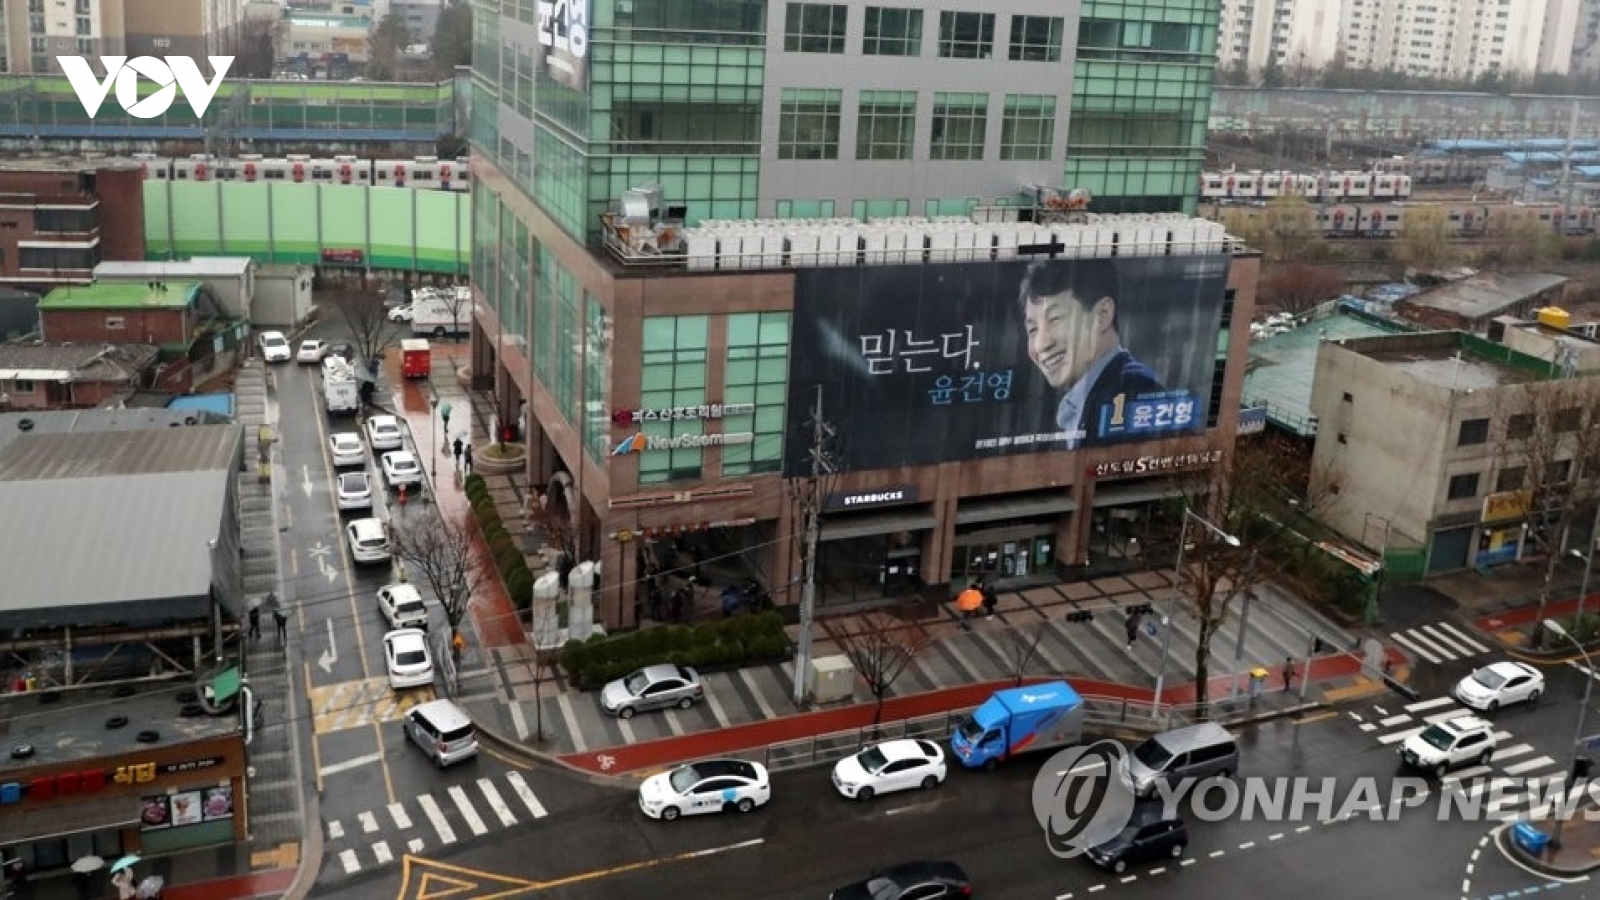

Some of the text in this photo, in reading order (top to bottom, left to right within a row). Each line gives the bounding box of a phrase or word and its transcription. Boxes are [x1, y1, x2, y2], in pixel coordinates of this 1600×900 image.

[860, 324, 980, 375] 믿는다.
[928, 369, 1013, 404] 윤건영
[1110, 393, 1126, 425] 1
[1133, 401, 1194, 428] 윤건영
[844, 490, 903, 506] STARBUCKS
